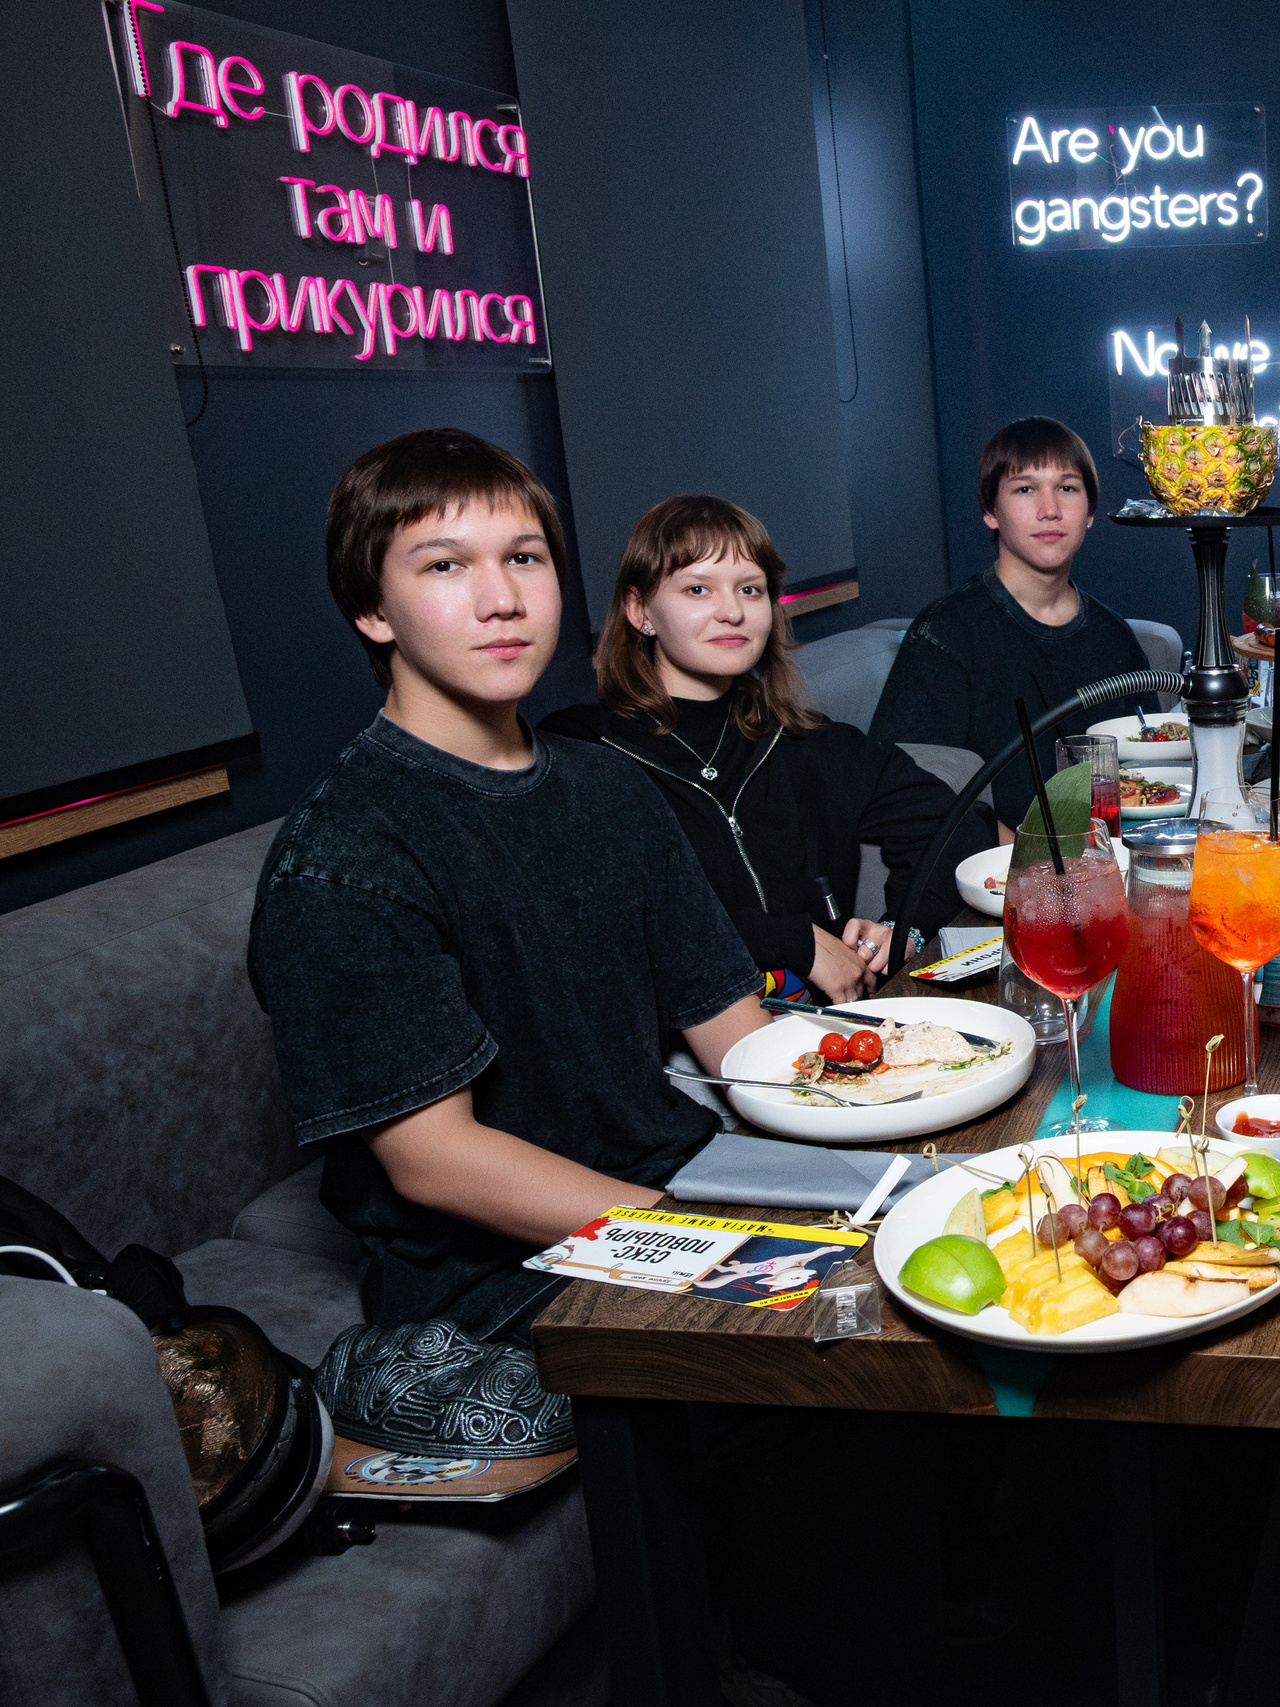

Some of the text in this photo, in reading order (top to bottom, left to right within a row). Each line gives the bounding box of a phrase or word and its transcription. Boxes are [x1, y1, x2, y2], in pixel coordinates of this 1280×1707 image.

[123, 0, 529, 177] Где родился
[1012, 116, 1204, 174] Are you
[276, 176, 453, 255] там и
[1014, 172, 1263, 246] gangsters?
[186, 264, 537, 360] прикурился
[604, 1227, 716, 1254] ПОВОДЫРЬ
[612, 1209, 769, 1233] MAFIA GAME UNIVERSE
[610, 1245, 672, 1264] СЕКС-
